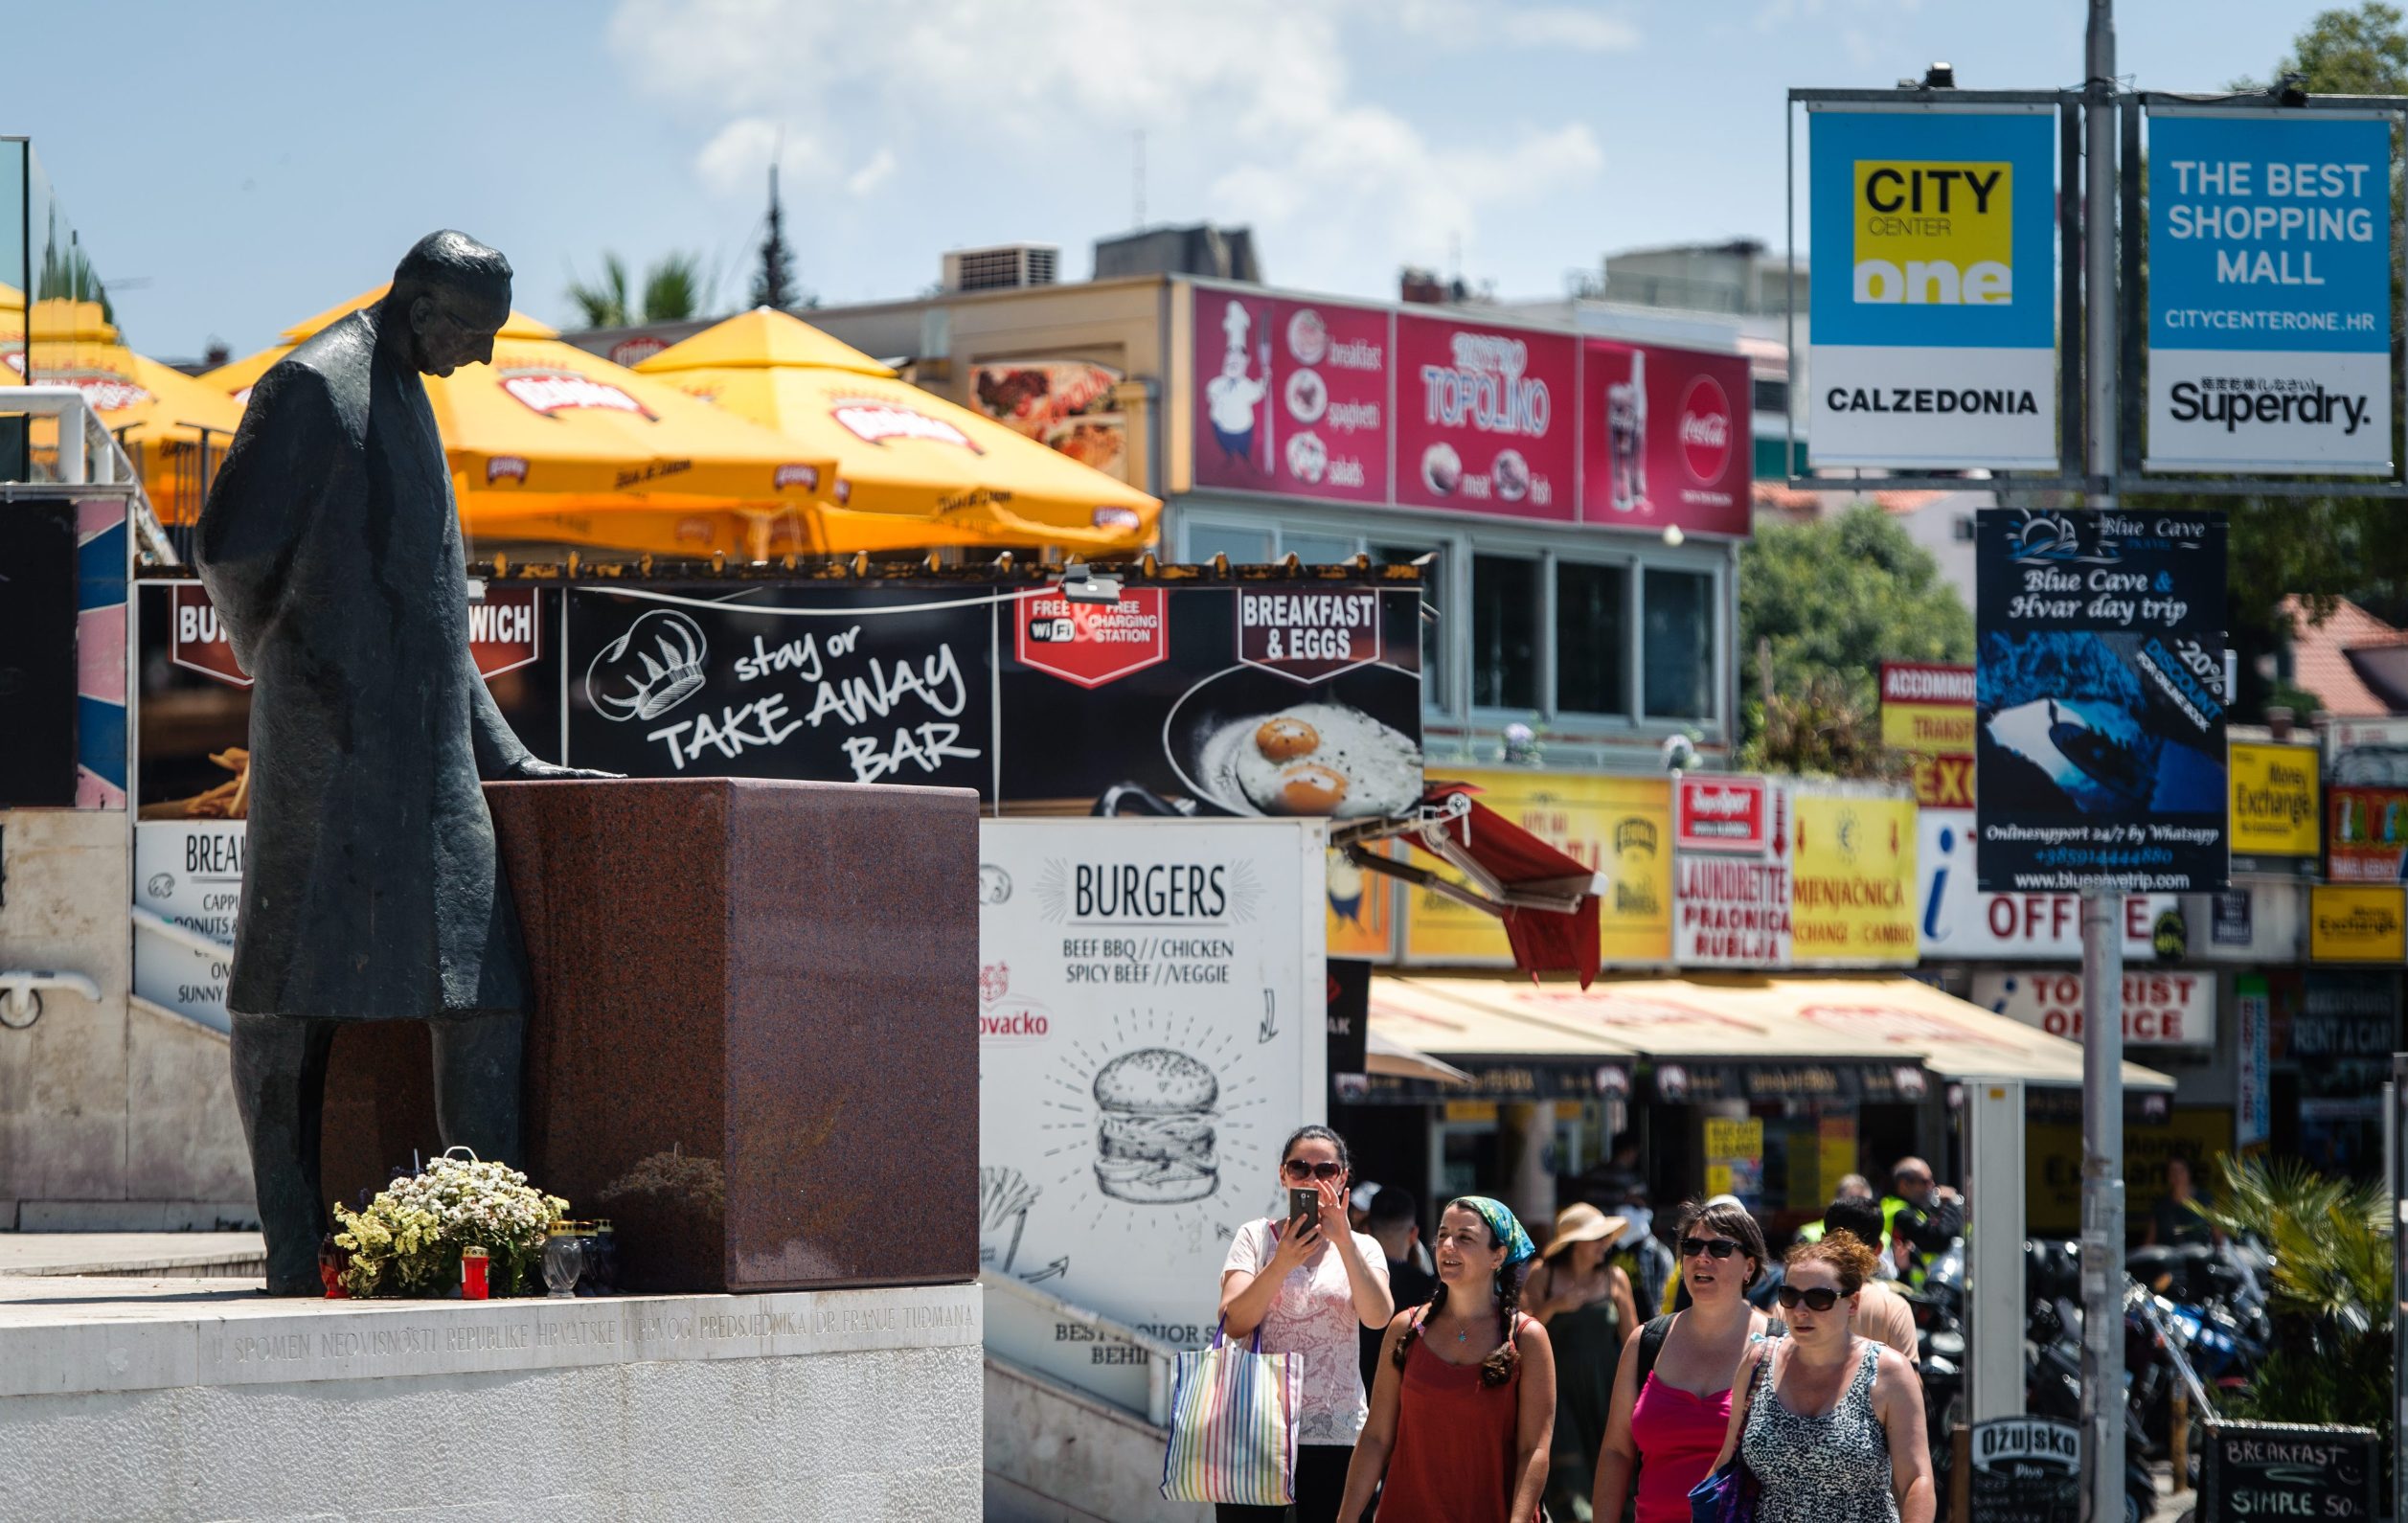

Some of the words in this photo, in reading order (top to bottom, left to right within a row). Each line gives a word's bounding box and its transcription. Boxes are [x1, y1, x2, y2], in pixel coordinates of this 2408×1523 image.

[1866, 169, 2001, 214] CITY
[2170, 161, 2252, 195] THE
[2266, 163, 2370, 198] BEST
[1870, 216, 1951, 237] CENTER
[2169, 204, 2374, 242] SHOPPING
[1853, 259, 2012, 305] one
[2216, 250, 2325, 285] MALL
[2166, 308, 2374, 331] CITYCENTERONE.HR
[1422, 366, 1550, 436] TOPOLINO
[1827, 387, 2039, 415] CALZEDONIA
[2170, 381, 2371, 434] Superdry.
[2155, 517, 2205, 537] Cave
[2024, 566, 2081, 592] Blue
[2088, 568, 2148, 592] Cave
[2153, 570, 2174, 593] &
[180, 605, 227, 644] BU
[468, 604, 531, 644] WICH
[1033, 601, 1070, 616] FREE
[1088, 613, 1157, 628] CHARGING
[1244, 596, 1375, 627] BREAKFAST
[2008, 593, 2082, 619] Hvar
[2087, 593, 2135, 625] day
[2142, 596, 2189, 626] trip
[1095, 628, 1149, 643] STATION
[1267, 630, 1284, 661] &
[1290, 628, 1351, 661] EGGS
[734, 632, 823, 681] stay
[827, 625, 860, 658] or
[1888, 670, 1976, 700] ACCOMMO
[2142, 636, 2222, 722] DISCOUNT
[647, 693, 803, 770] TAKE
[805, 643, 966, 725] AWAY
[841, 721, 982, 784] BAR
[2269, 762, 2306, 785] Money
[2238, 784, 2311, 825] Exchange
[1986, 824, 2089, 845] Onlinesupport
[2128, 824, 2147, 845] by
[2148, 824, 2219, 845] Whatsapp
[1076, 864, 1226, 918] BURGERS
[1678, 860, 1787, 905] LAUNDRETTE
[1684, 906, 1791, 934] PRAONICA
[1864, 921, 1915, 944] CAMBIO
[1063, 939, 1100, 958] BEEF
[1102, 939, 1138, 964] BBQ
[1161, 939, 1234, 958] CHICKEN
[1696, 934, 1779, 959] RUBLJA
[1066, 964, 1109, 984] SPICY
[1114, 964, 1150, 983] BEEF
[178, 985, 223, 1004] SUNNY
[2031, 975, 2197, 1006] TORIST
[2293, 1017, 2339, 1052] RENT
[2344, 1020, 2355, 1053] A
[2358, 1019, 2392, 1053] CAR
[213, 1341, 224, 1364] U
[235, 1333, 311, 1363] SPOMEN
[322, 1328, 437, 1359] NEOVISNOSTI
[446, 1324, 529, 1353] REPUBLIKE
[537, 1320, 616, 1348] HRVATSKE
[636, 1316, 692, 1342] PRVOG
[699, 1311, 806, 1341] PREDSJEDNIKA
[844, 1307, 896, 1334] FRANJE
[1981, 1423, 2077, 1457] Ožujsko
[2226, 1440, 2348, 1466] BREAKFAST
[2230, 1489, 2316, 1516] SIMPLE
